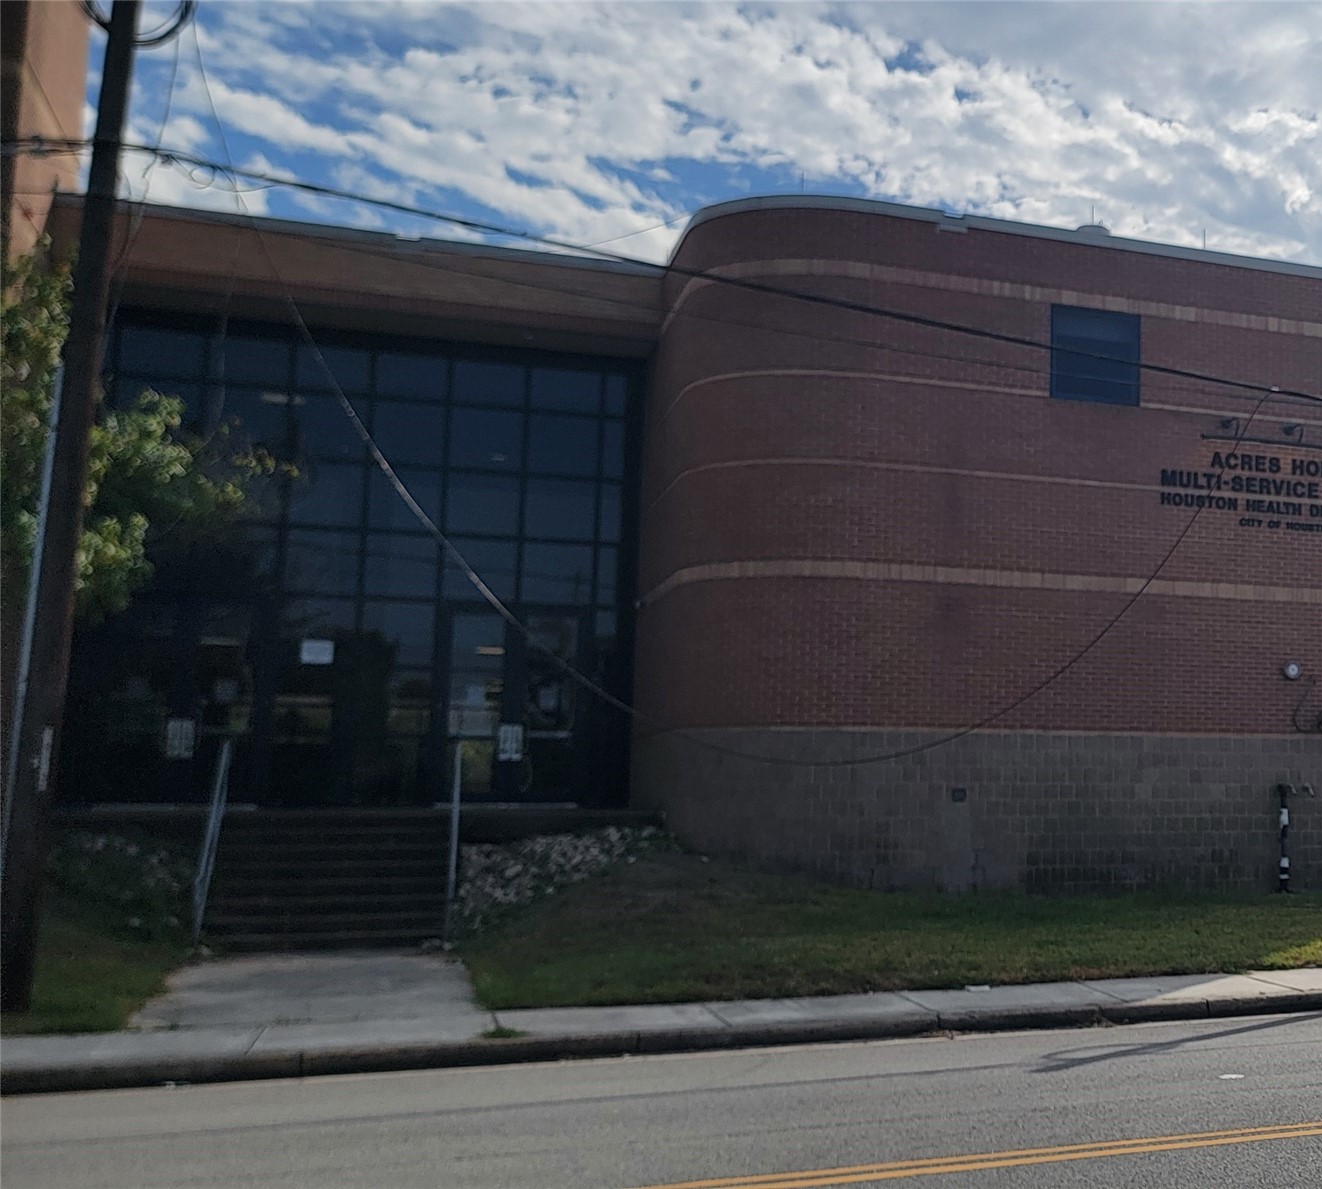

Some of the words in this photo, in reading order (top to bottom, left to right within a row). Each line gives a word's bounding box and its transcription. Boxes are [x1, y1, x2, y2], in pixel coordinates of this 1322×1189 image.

[1211, 451, 1281, 473] ACRES
[1161, 469, 1319, 499] MULTI-SERVICE
[1160, 492, 1238, 511] HOUSTON
[1246, 499, 1302, 516] HEALTH
[1239, 518, 1263, 528] CITY
[1268, 519, 1281, 529] OF
